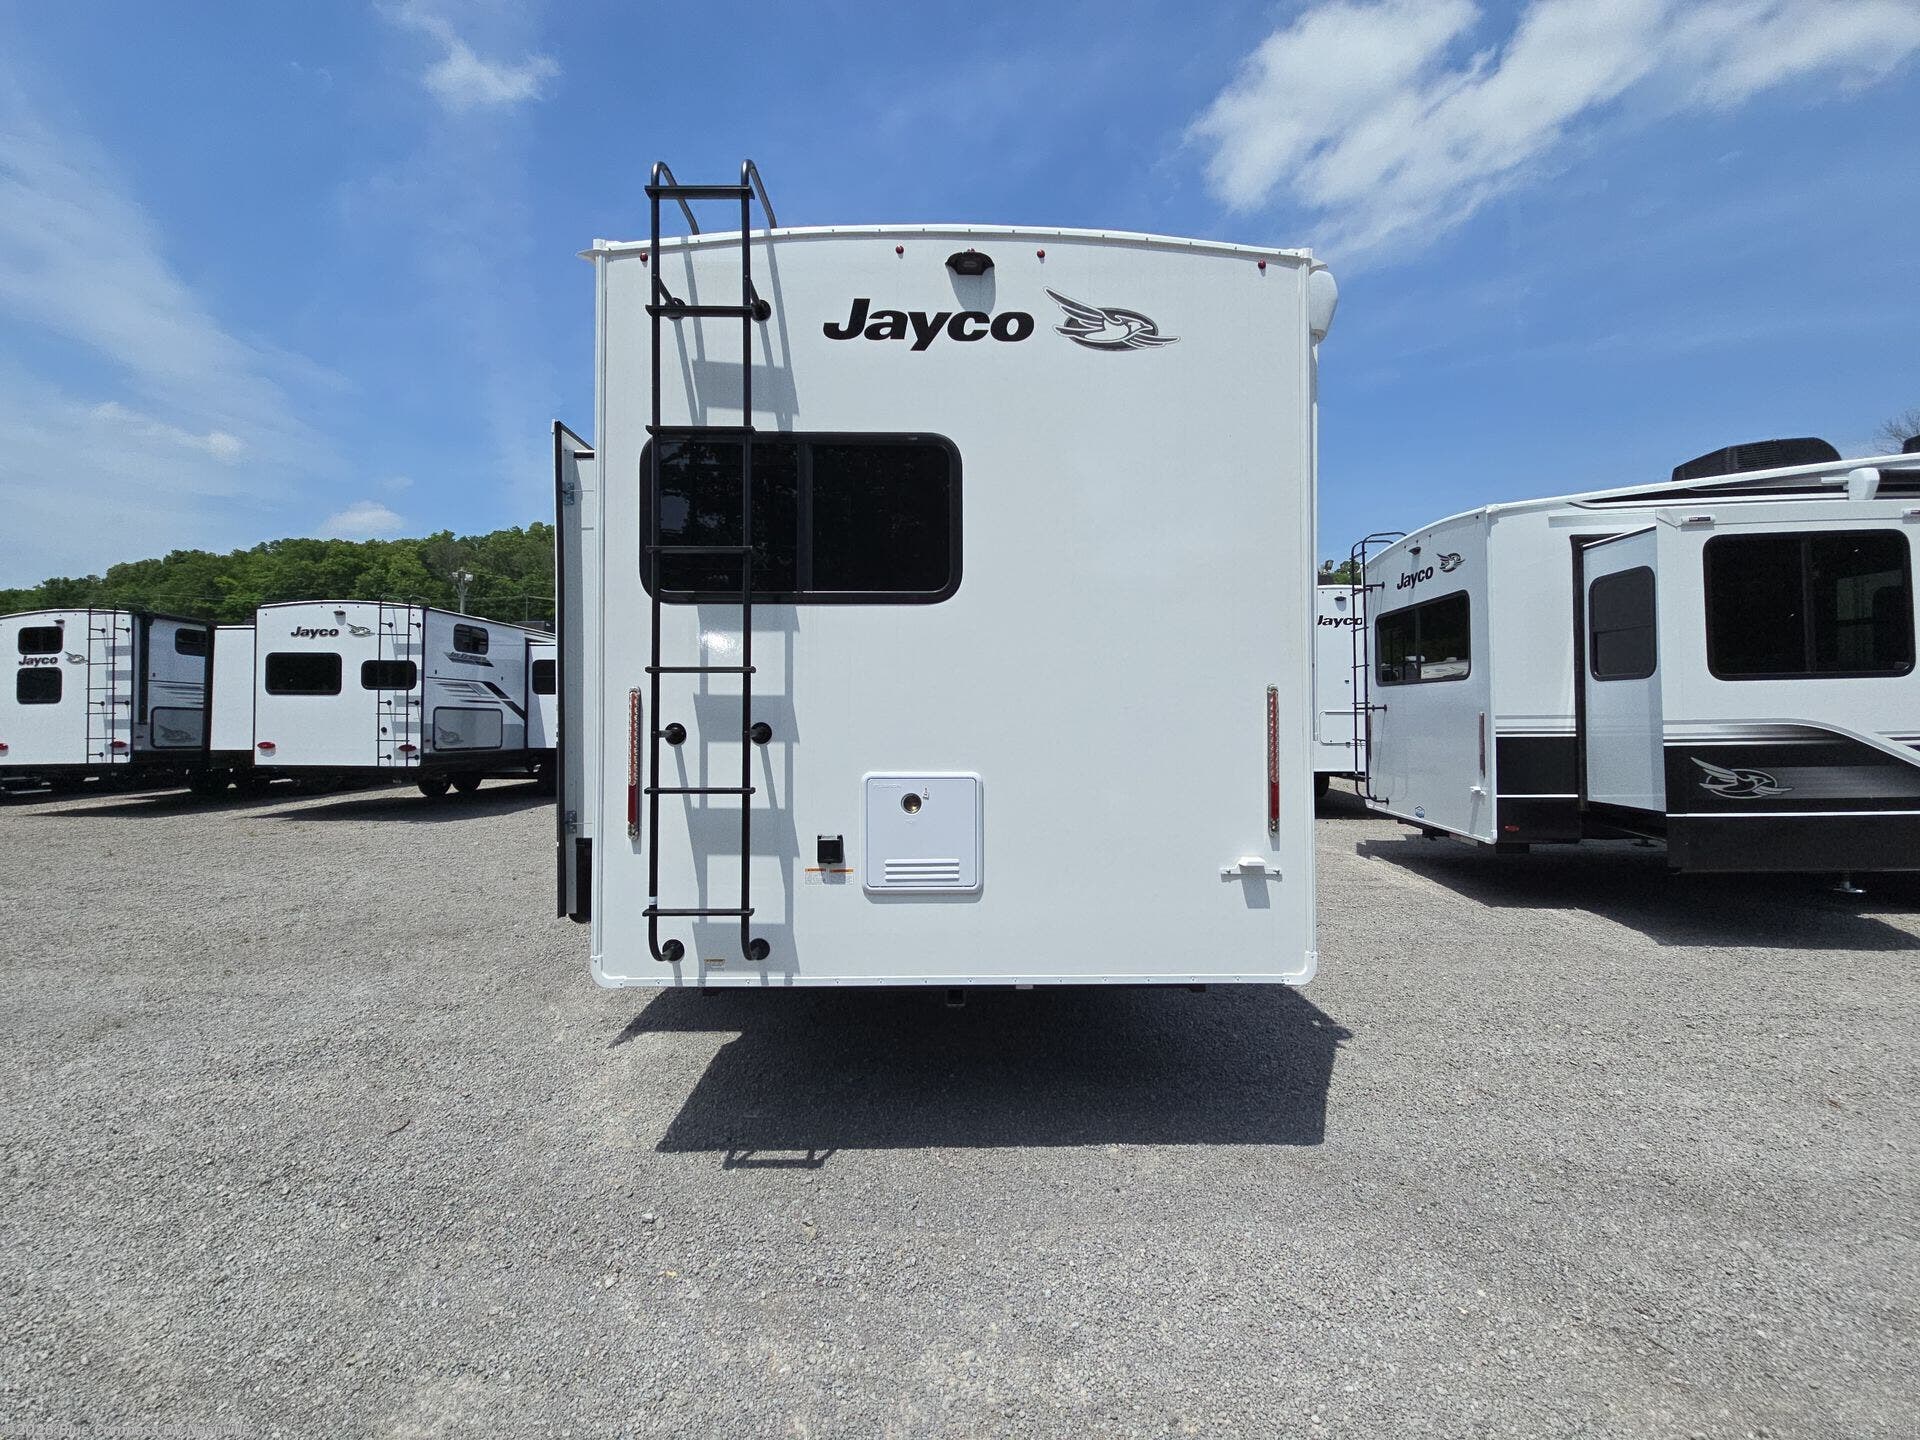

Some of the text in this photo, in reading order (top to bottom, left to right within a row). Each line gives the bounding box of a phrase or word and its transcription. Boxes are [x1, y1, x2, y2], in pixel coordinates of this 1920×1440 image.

[823, 298, 1035, 351] Jayco
[1396, 566, 1434, 590] Jayco
[290, 626, 339, 639] Jayco
[18, 655, 58, 667] Jayco
